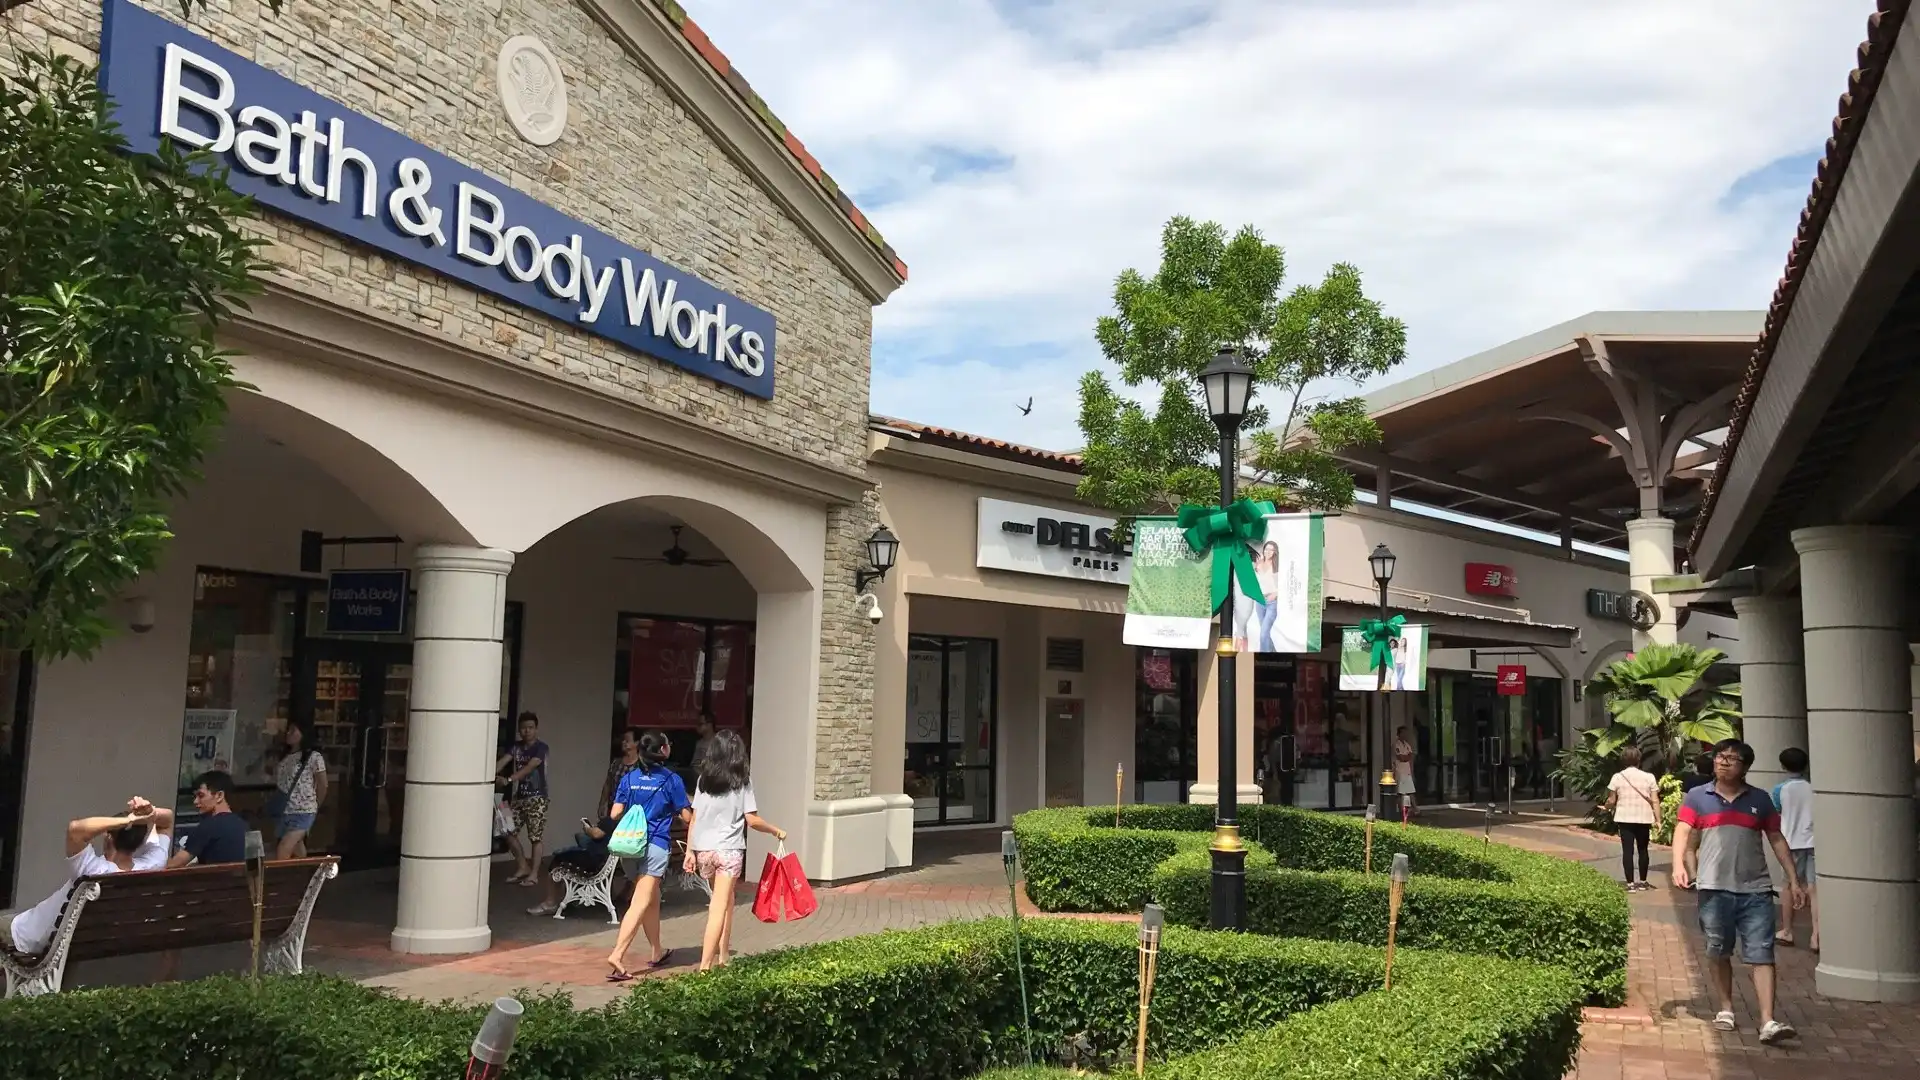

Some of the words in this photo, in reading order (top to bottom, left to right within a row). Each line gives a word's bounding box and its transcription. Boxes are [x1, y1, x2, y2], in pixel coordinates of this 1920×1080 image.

[160, 42, 378, 218] Bath
[389, 156, 447, 248] &
[457, 181, 615, 323] Body
[620, 257, 766, 378] Works
[1139, 534, 1162, 543] HARI
[1138, 542, 1164, 551] AIDIL
[1165, 543, 1189, 551] FITRI
[1137, 550, 1168, 559] MAAF
[1169, 551, 1200, 560] ZAHIR
[1072, 556, 1119, 572] PARIS
[1136, 558, 1144, 567] &
[332, 588, 358, 600] Bath
[368, 588, 398, 602] Body
[347, 604, 383, 616] Works
[917, 715, 961, 739] SAE
[194, 735, 217, 760] 50
